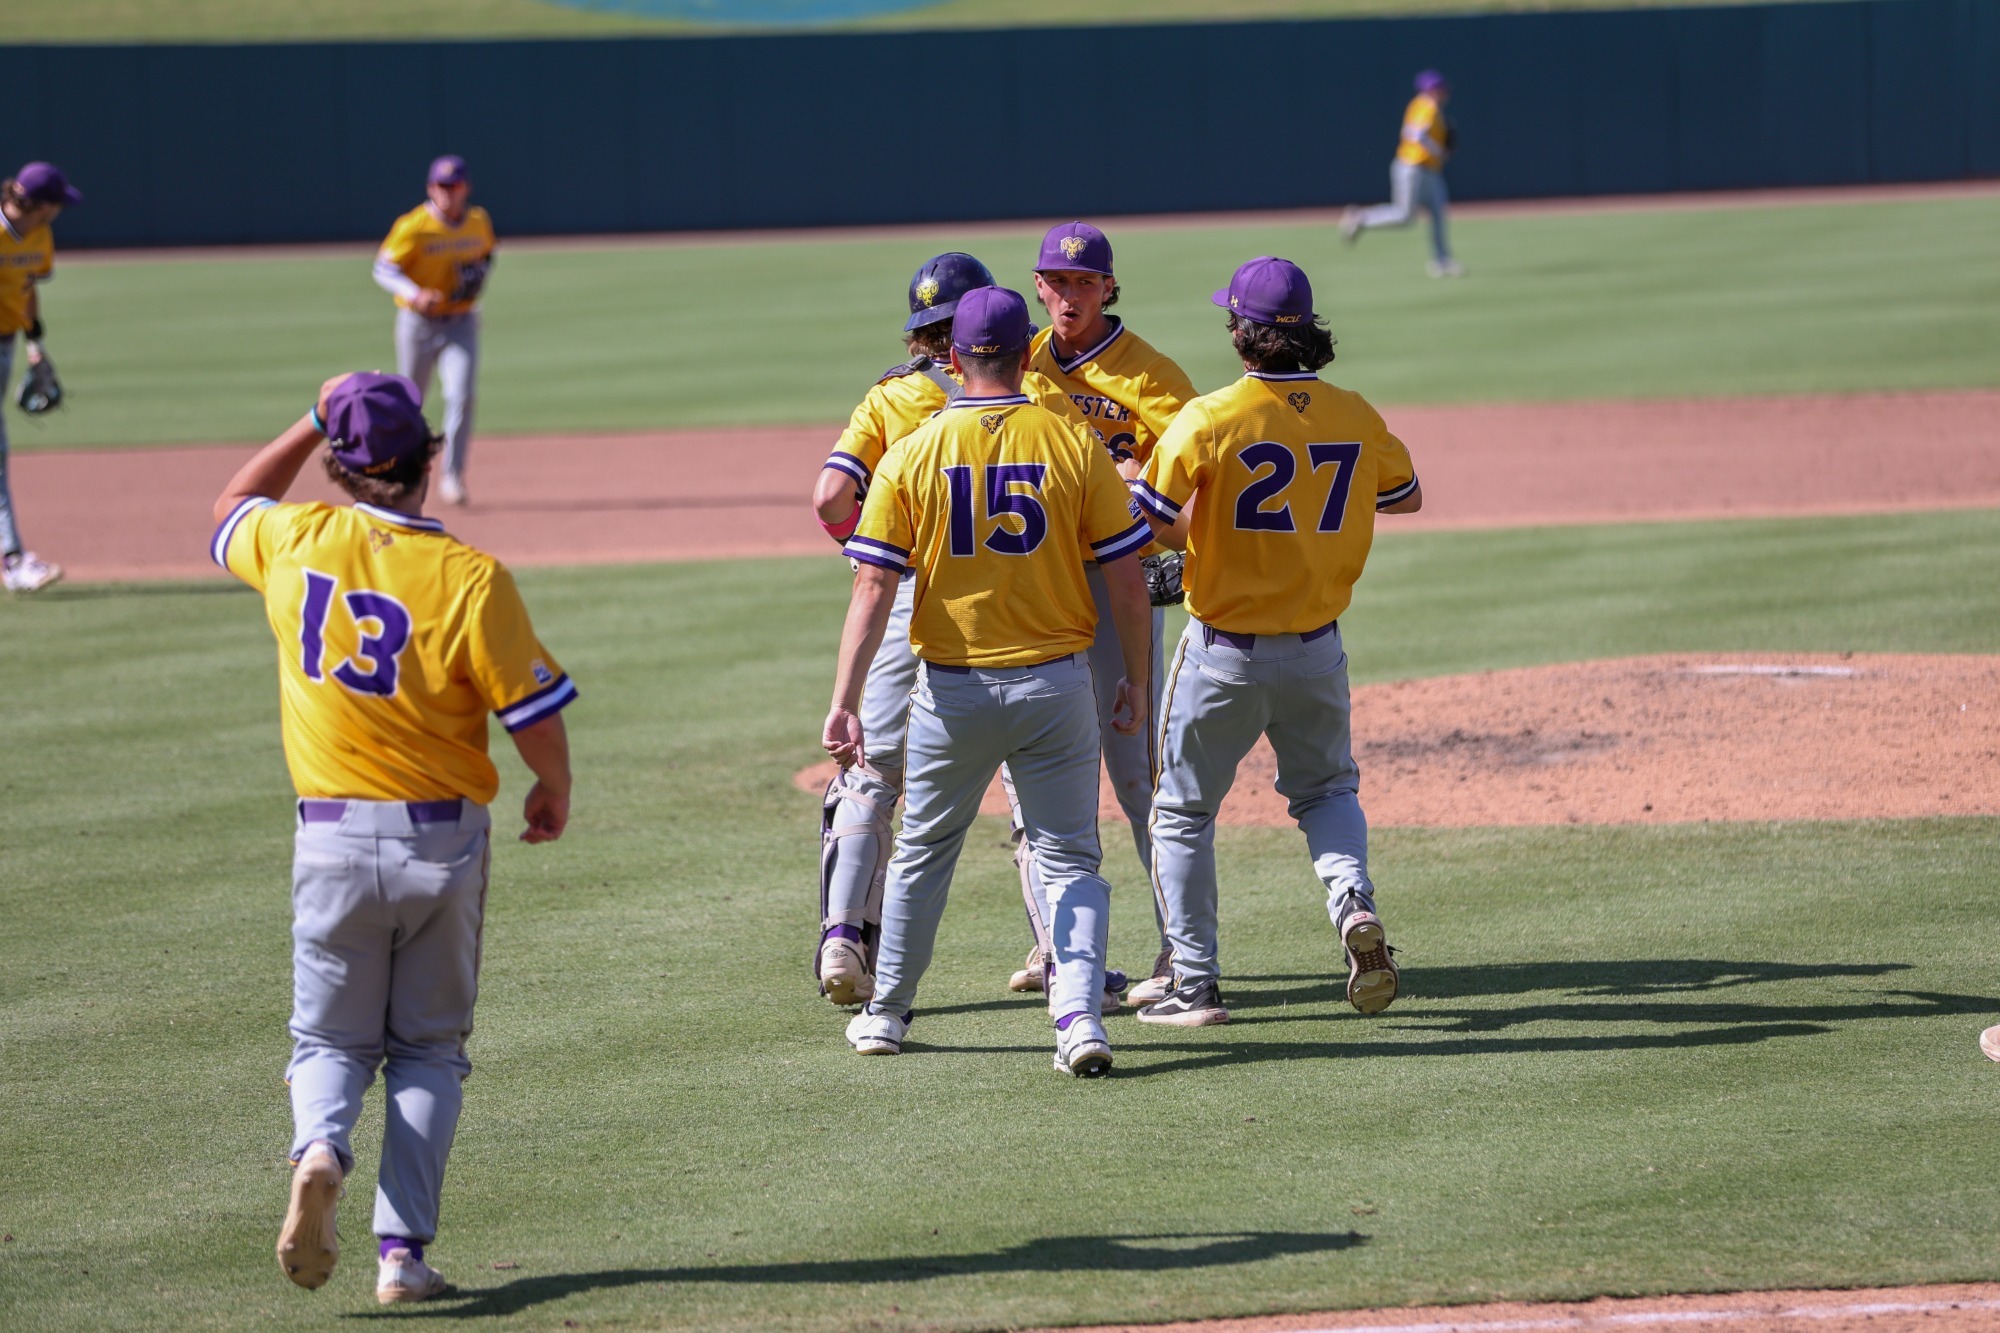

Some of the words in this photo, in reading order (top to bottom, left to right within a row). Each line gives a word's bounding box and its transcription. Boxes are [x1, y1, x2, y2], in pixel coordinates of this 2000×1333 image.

[971, 344, 1001, 354] WCU
[1069, 393, 1131, 423] ESTER
[939, 462, 1049, 558] 15
[1234, 441, 1363, 533] 27
[297, 565, 414, 699] 13
